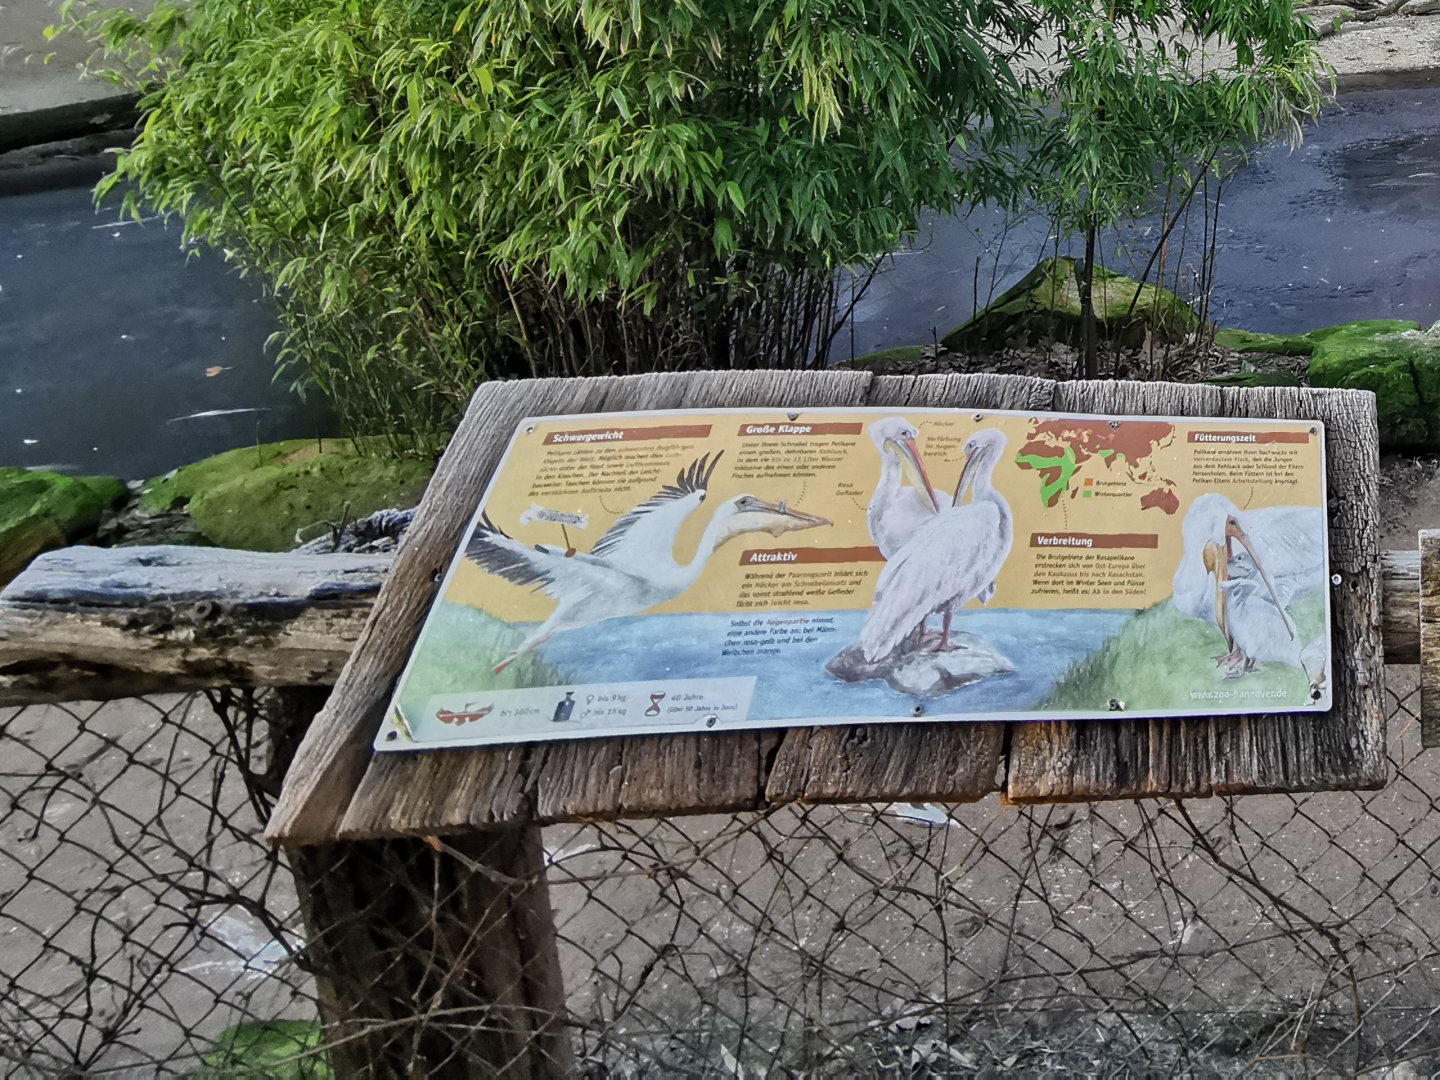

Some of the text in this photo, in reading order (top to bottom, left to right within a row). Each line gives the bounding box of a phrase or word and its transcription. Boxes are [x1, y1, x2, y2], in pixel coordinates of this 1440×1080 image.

[746, 424, 812, 434] Große Klappe
[552, 431, 624, 443] Schwergewicht
[1195, 433, 1257, 444] Fütterungszeit
[1037, 535, 1093, 548] Verbreitung
[750, 551, 798, 562] Attraktiv
